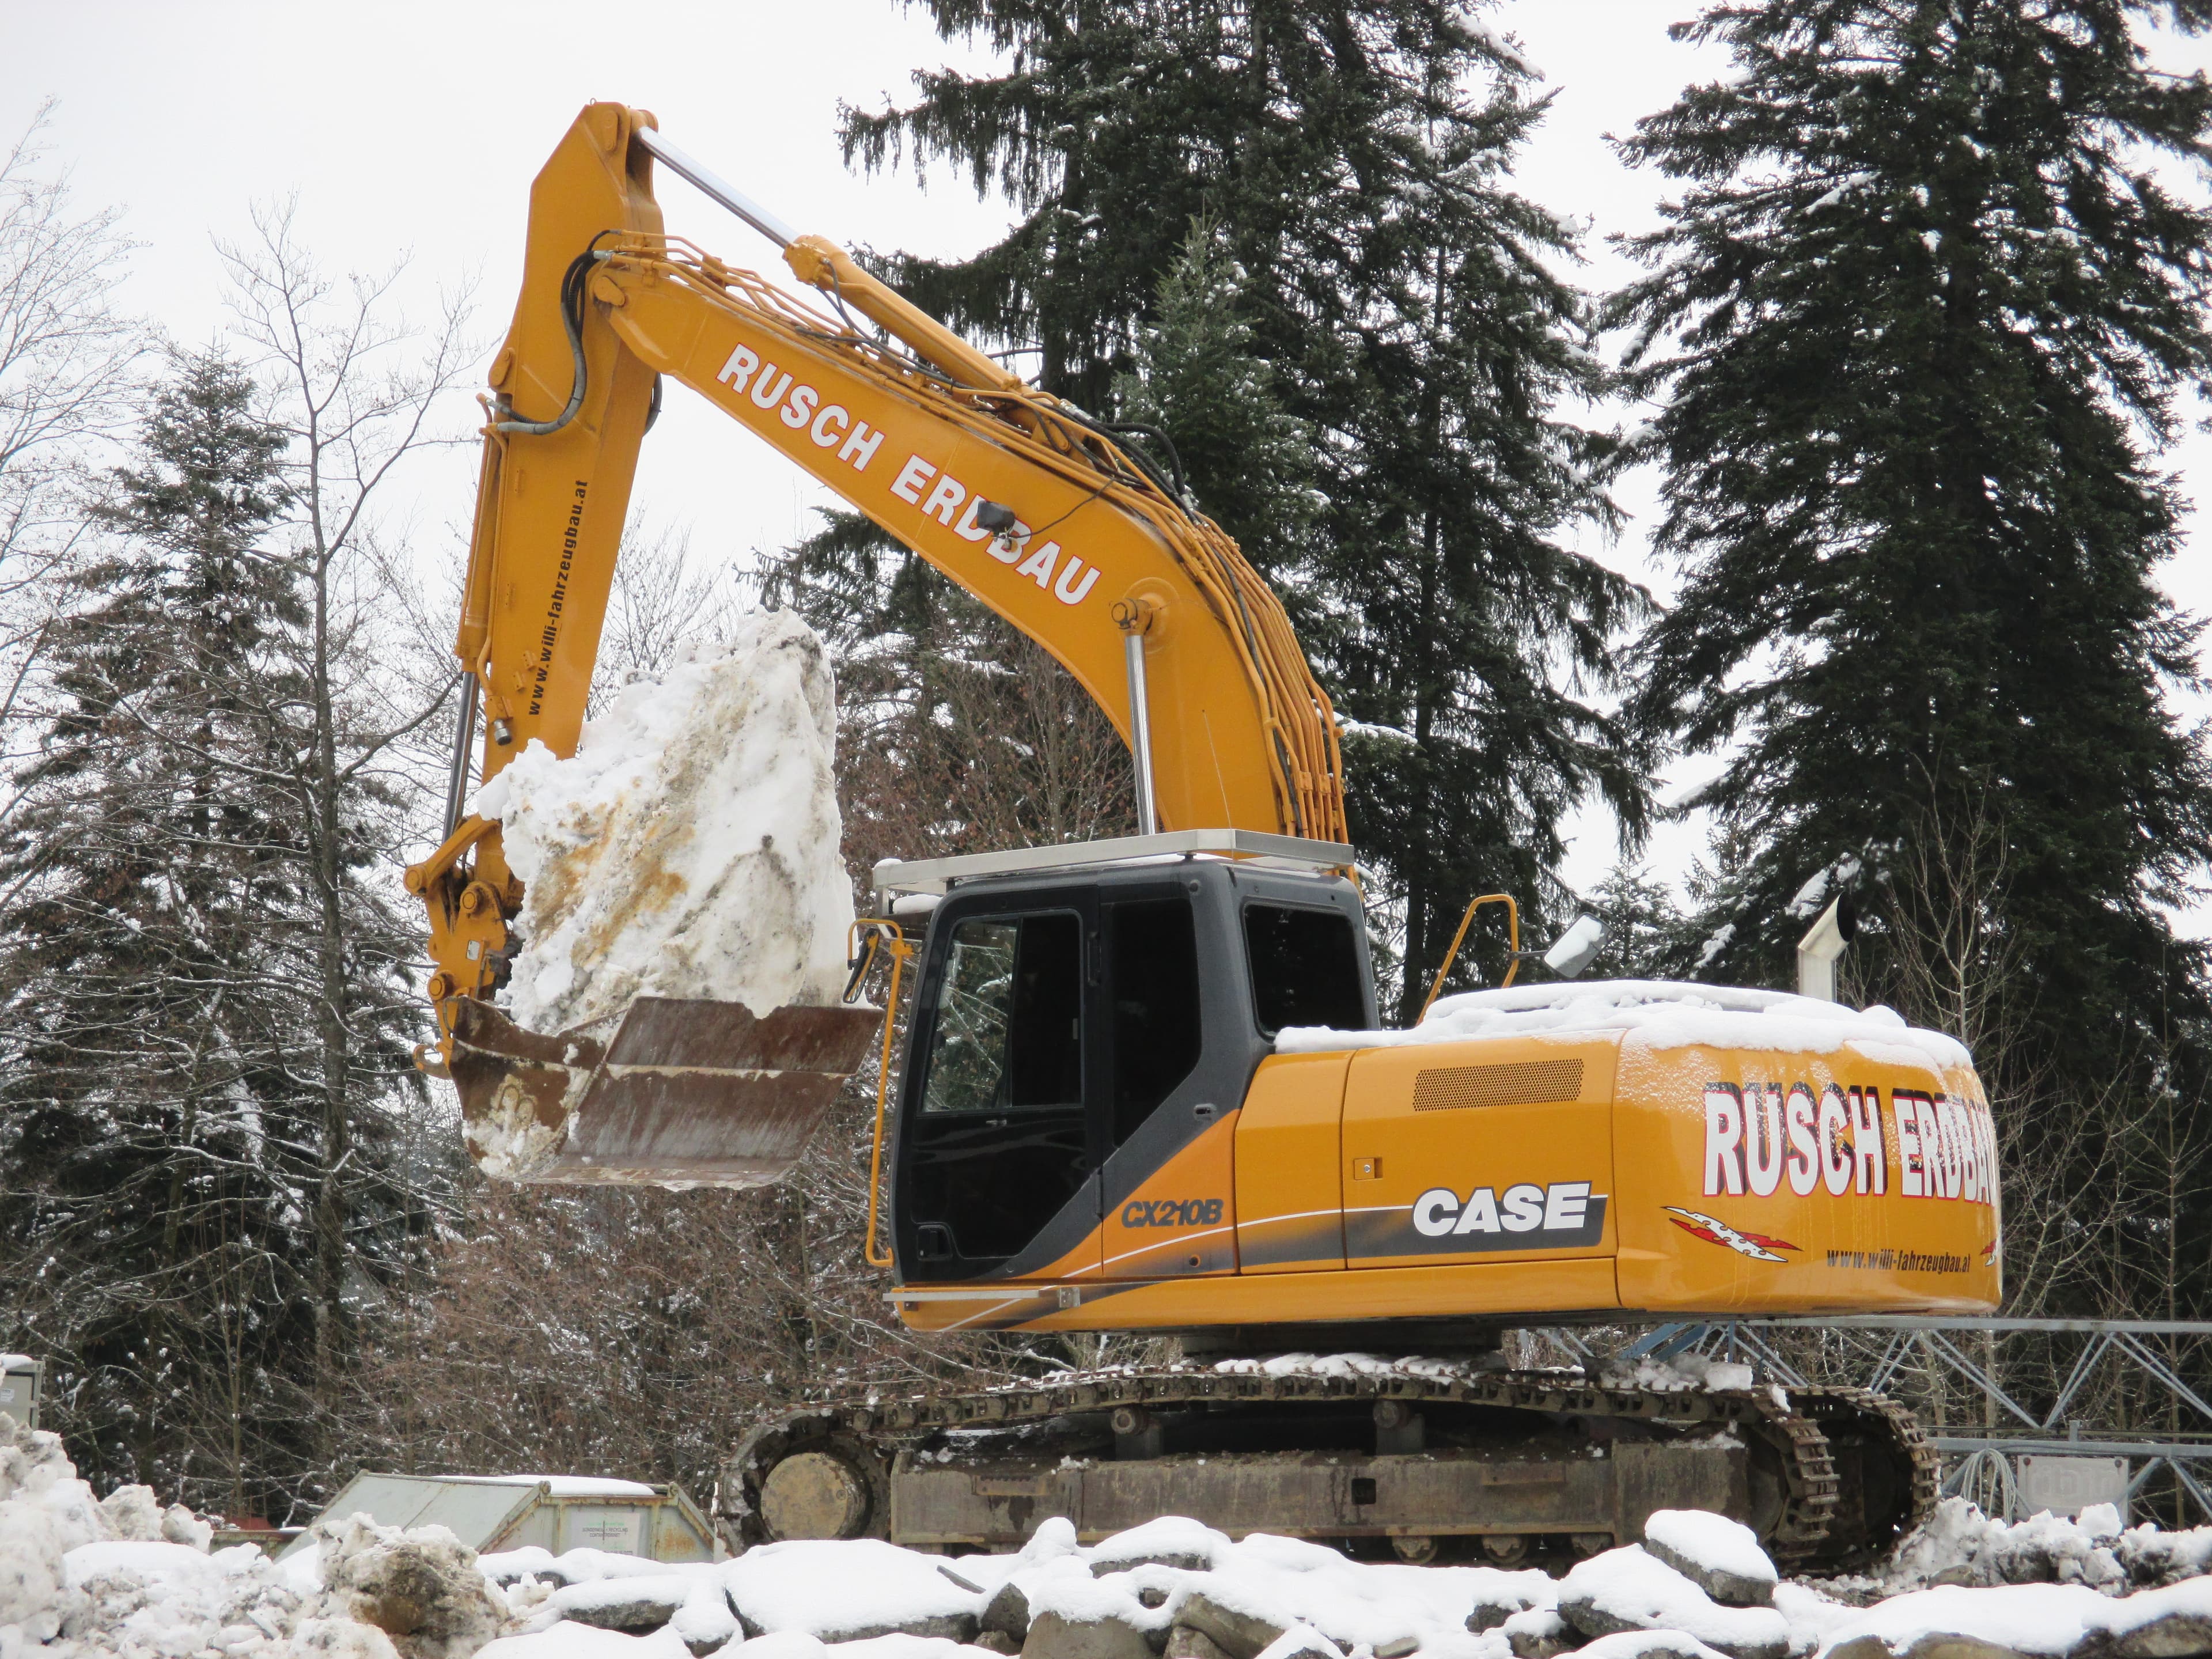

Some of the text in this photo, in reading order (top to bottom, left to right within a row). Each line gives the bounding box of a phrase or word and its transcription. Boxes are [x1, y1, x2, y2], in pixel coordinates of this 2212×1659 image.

[715, 342, 1101, 605] RUSCH ERDBAU
[529, 480, 588, 716] www.willi-fahrzeugbau.at
[1702, 1081, 1887, 1198] RUSCH
[1121, 1199, 1224, 1229] CX210B
[1412, 1180, 1592, 1237] CASE
[1827, 1248, 1971, 1275] www.willi-fahrzeugbau.at
